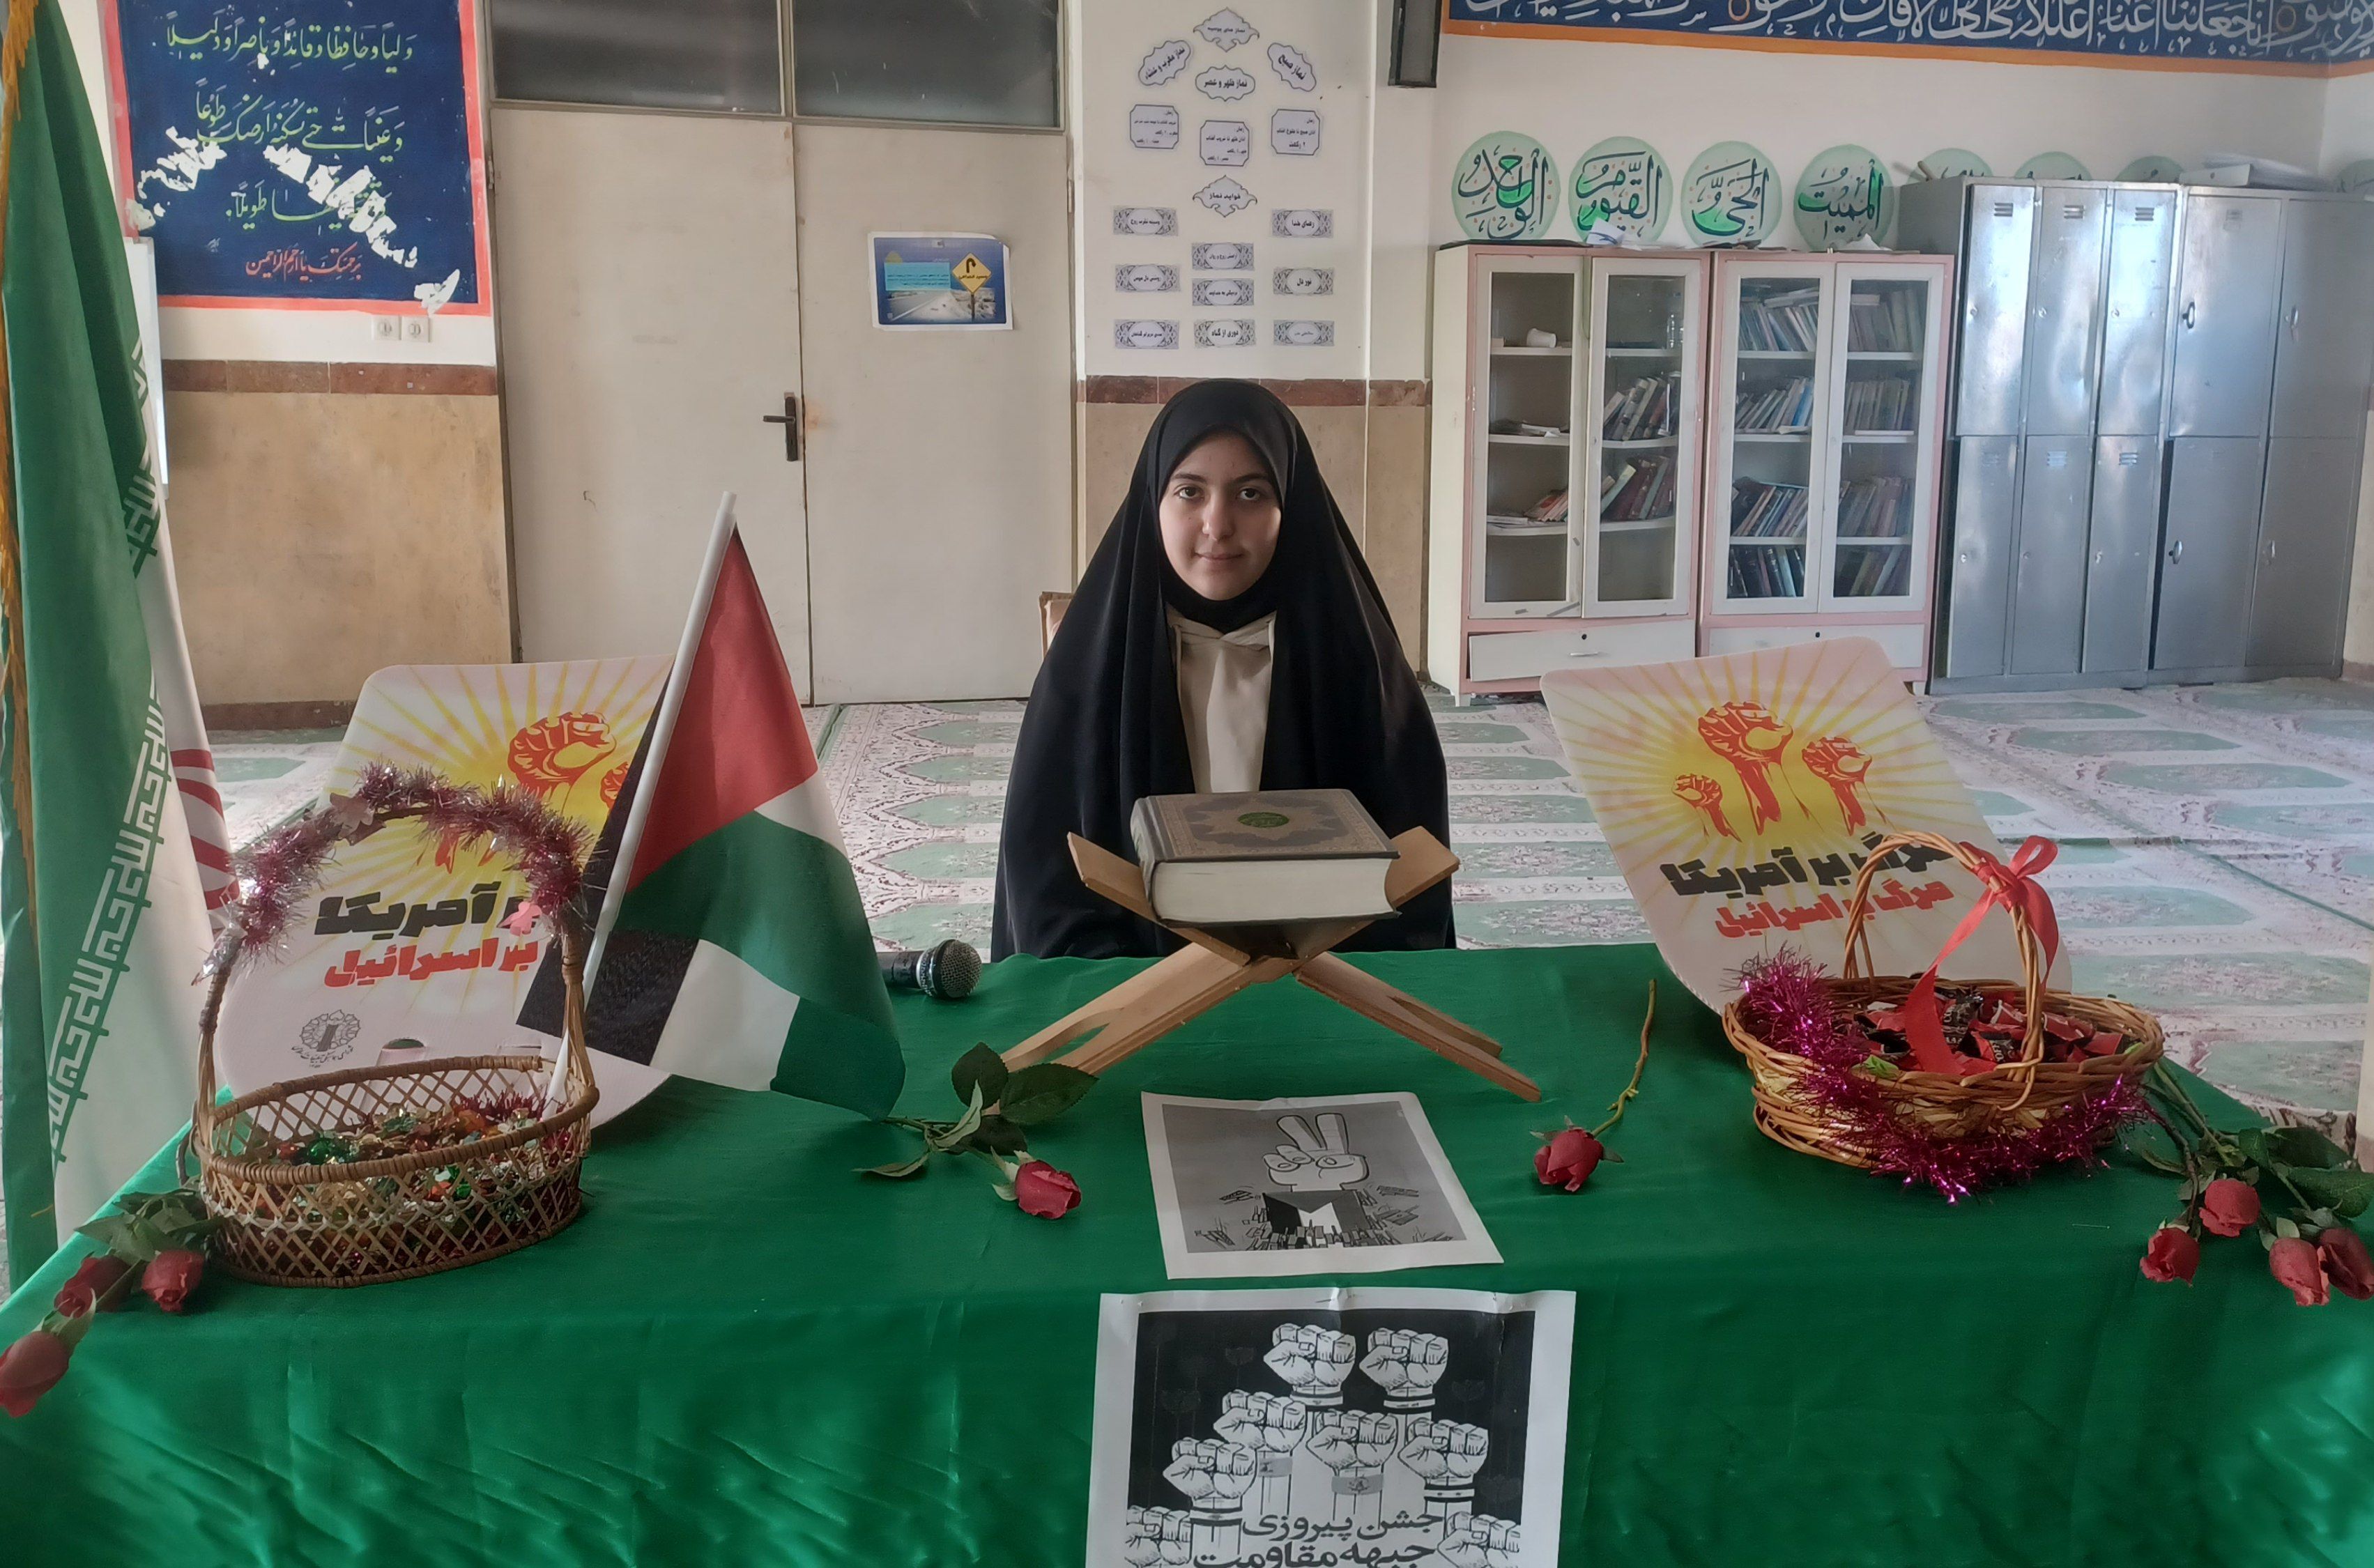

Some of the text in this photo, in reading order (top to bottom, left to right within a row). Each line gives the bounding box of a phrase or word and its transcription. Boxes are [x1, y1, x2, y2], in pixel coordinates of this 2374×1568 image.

[1660, 847, 1808, 899] آمریکا
[1807, 852, 1851, 886] بر
[314, 881, 502, 940] آمریکا
[1872, 878, 1954, 910] مرگ
[1715, 893, 1844, 938] اسرائیل
[324, 937, 538, 987] بر اسرائیل
[1243, 1510, 1443, 1542] جشن پیروزی
[1193, 1541, 1437, 1568] جبهه مقاومت
